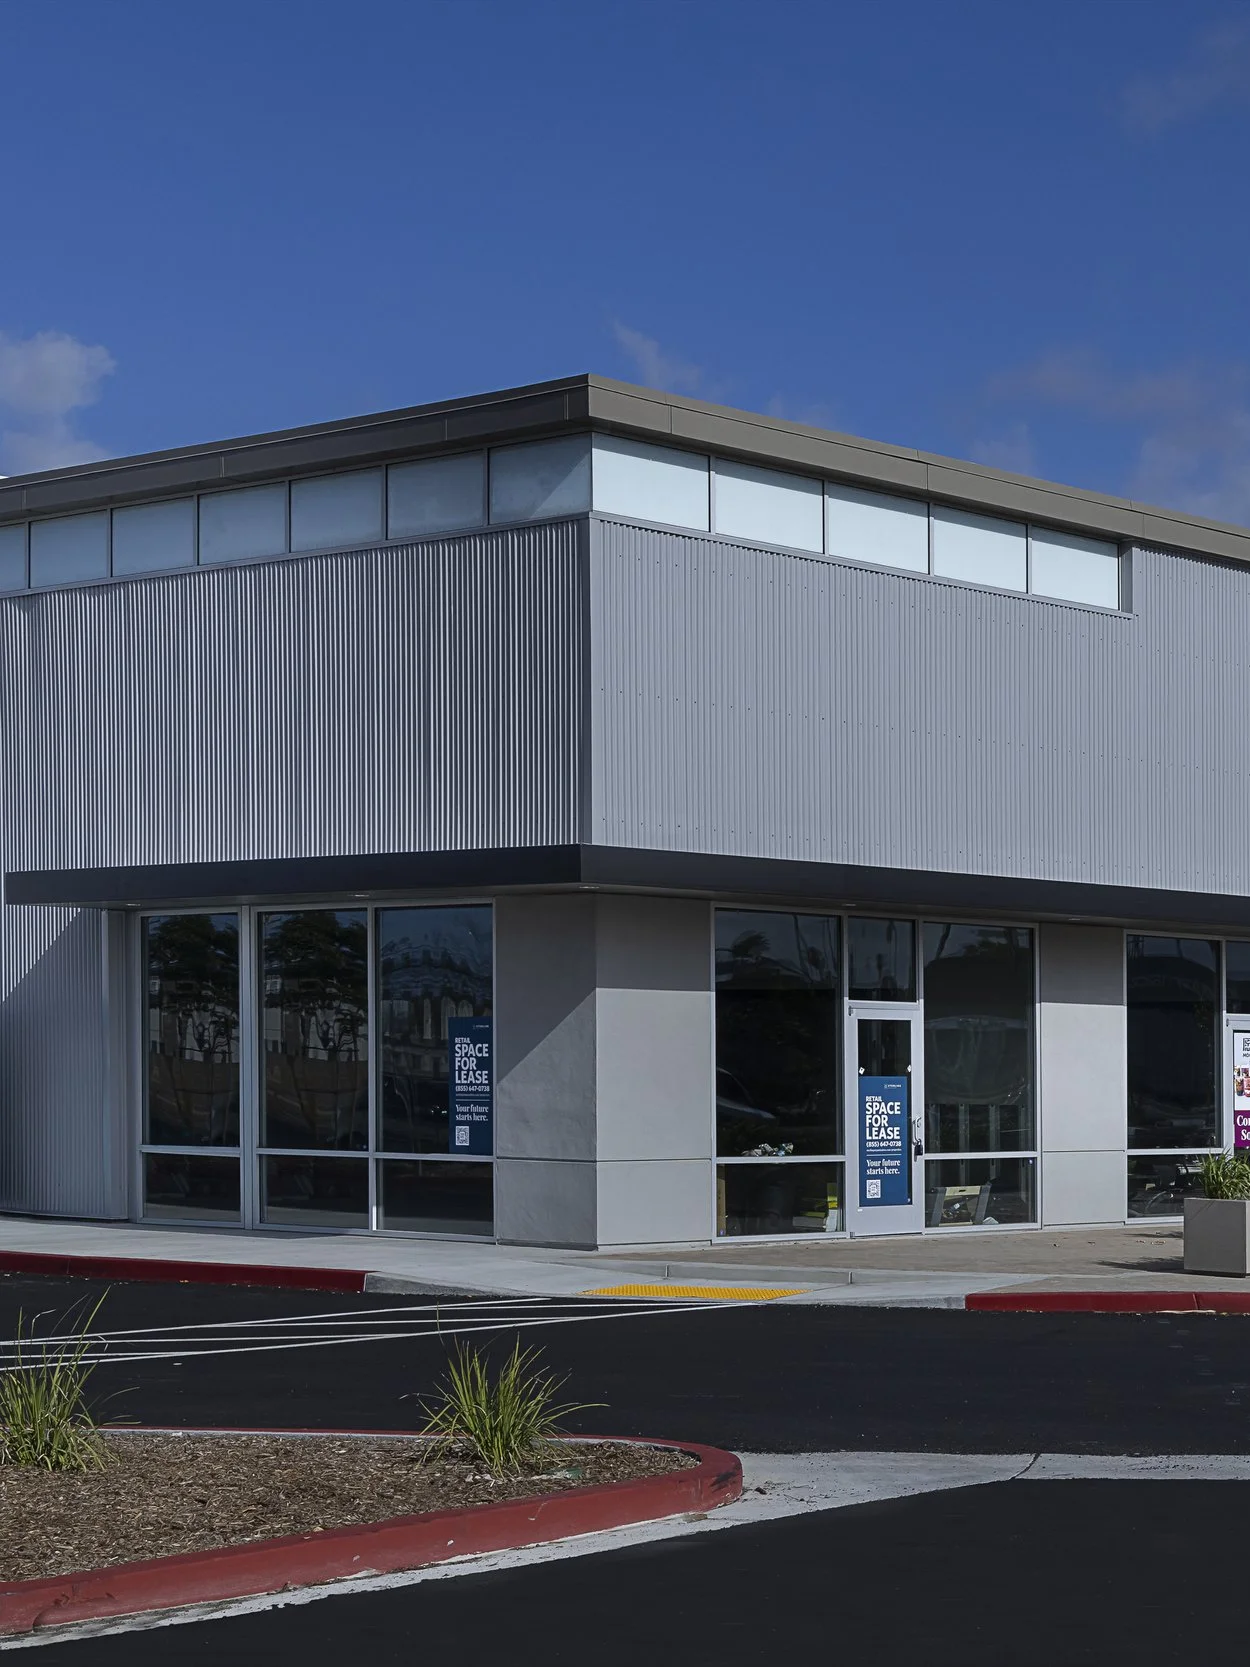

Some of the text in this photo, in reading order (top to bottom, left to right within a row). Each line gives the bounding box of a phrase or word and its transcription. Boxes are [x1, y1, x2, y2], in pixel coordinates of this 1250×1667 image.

[455, 1044, 489, 1057] SPACE
[455, 1057, 476, 1070] FOR
[456, 1071, 488, 1084] LEASE
[471, 1104, 488, 1112] future
[866, 1102, 901, 1115] SPACE
[473, 1113, 488, 1121] here.
[866, 1115, 888, 1127] FOR
[866, 1127, 900, 1140] LEASE
